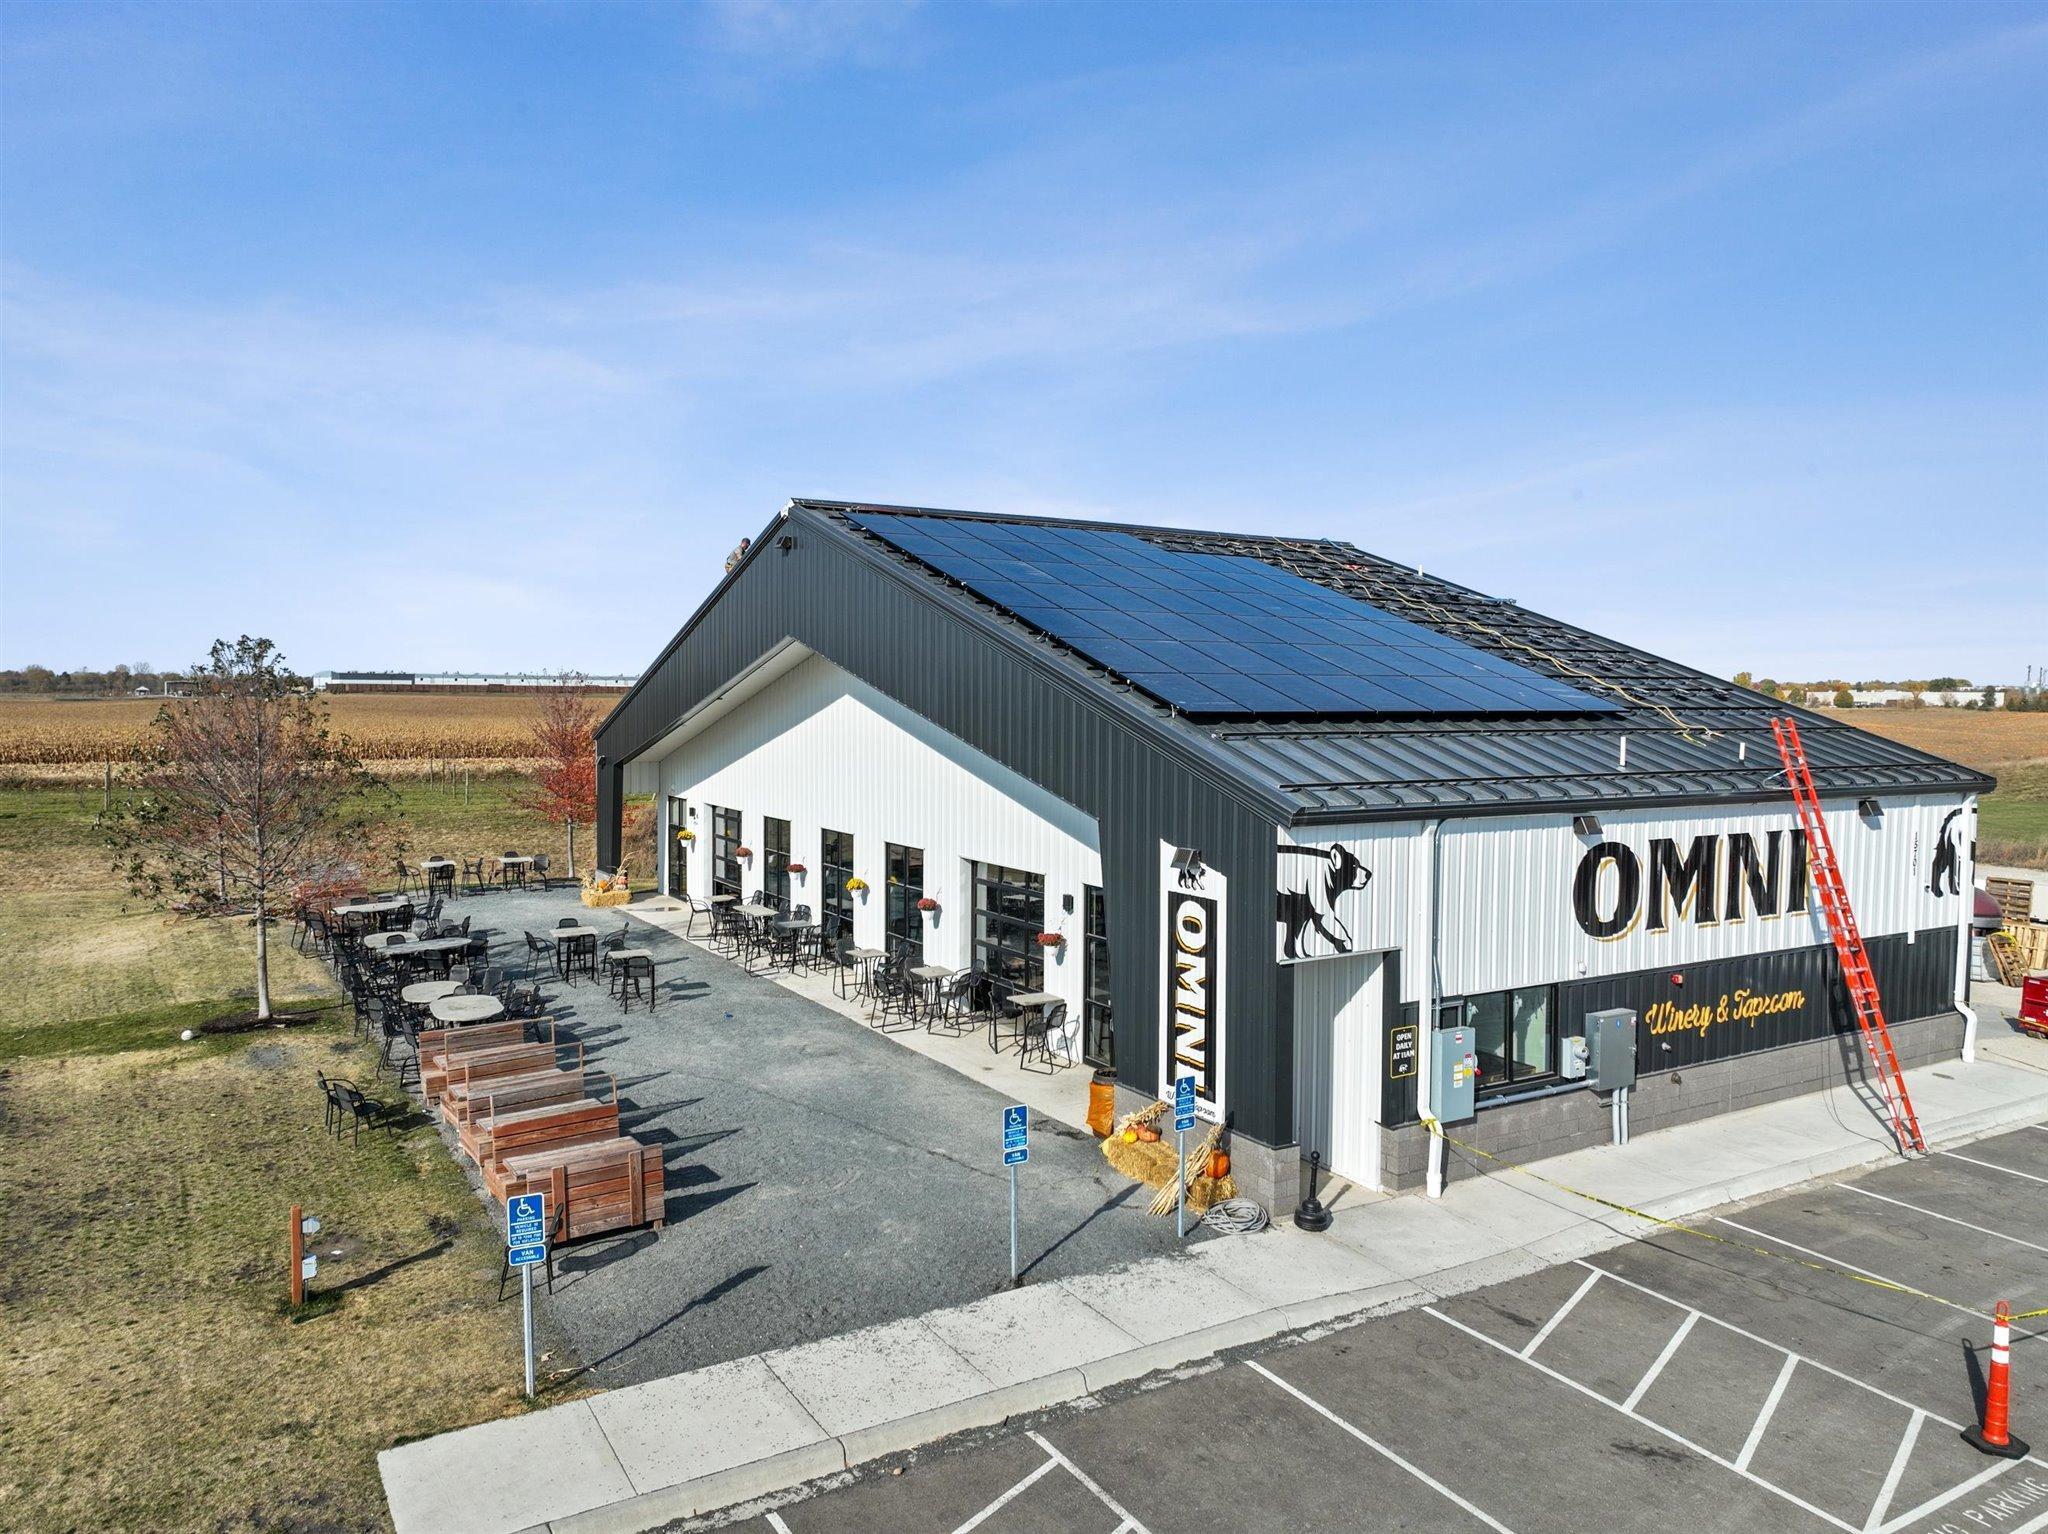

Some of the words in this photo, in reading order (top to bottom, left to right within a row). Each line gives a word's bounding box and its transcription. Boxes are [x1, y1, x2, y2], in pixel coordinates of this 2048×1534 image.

[1573, 828, 1811, 942] OMNI
[1175, 900, 1207, 1099] OMNI
[1645, 1000, 1713, 1037] Winery
[1716, 994, 1729, 1023] &
[1392, 1052, 1401, 1060] AT
[1395, 1041, 1412, 1050] DAILY
[1396, 1033, 1412, 1041] OPEN
[1962, 1477, 2048, 1529] PARKING
